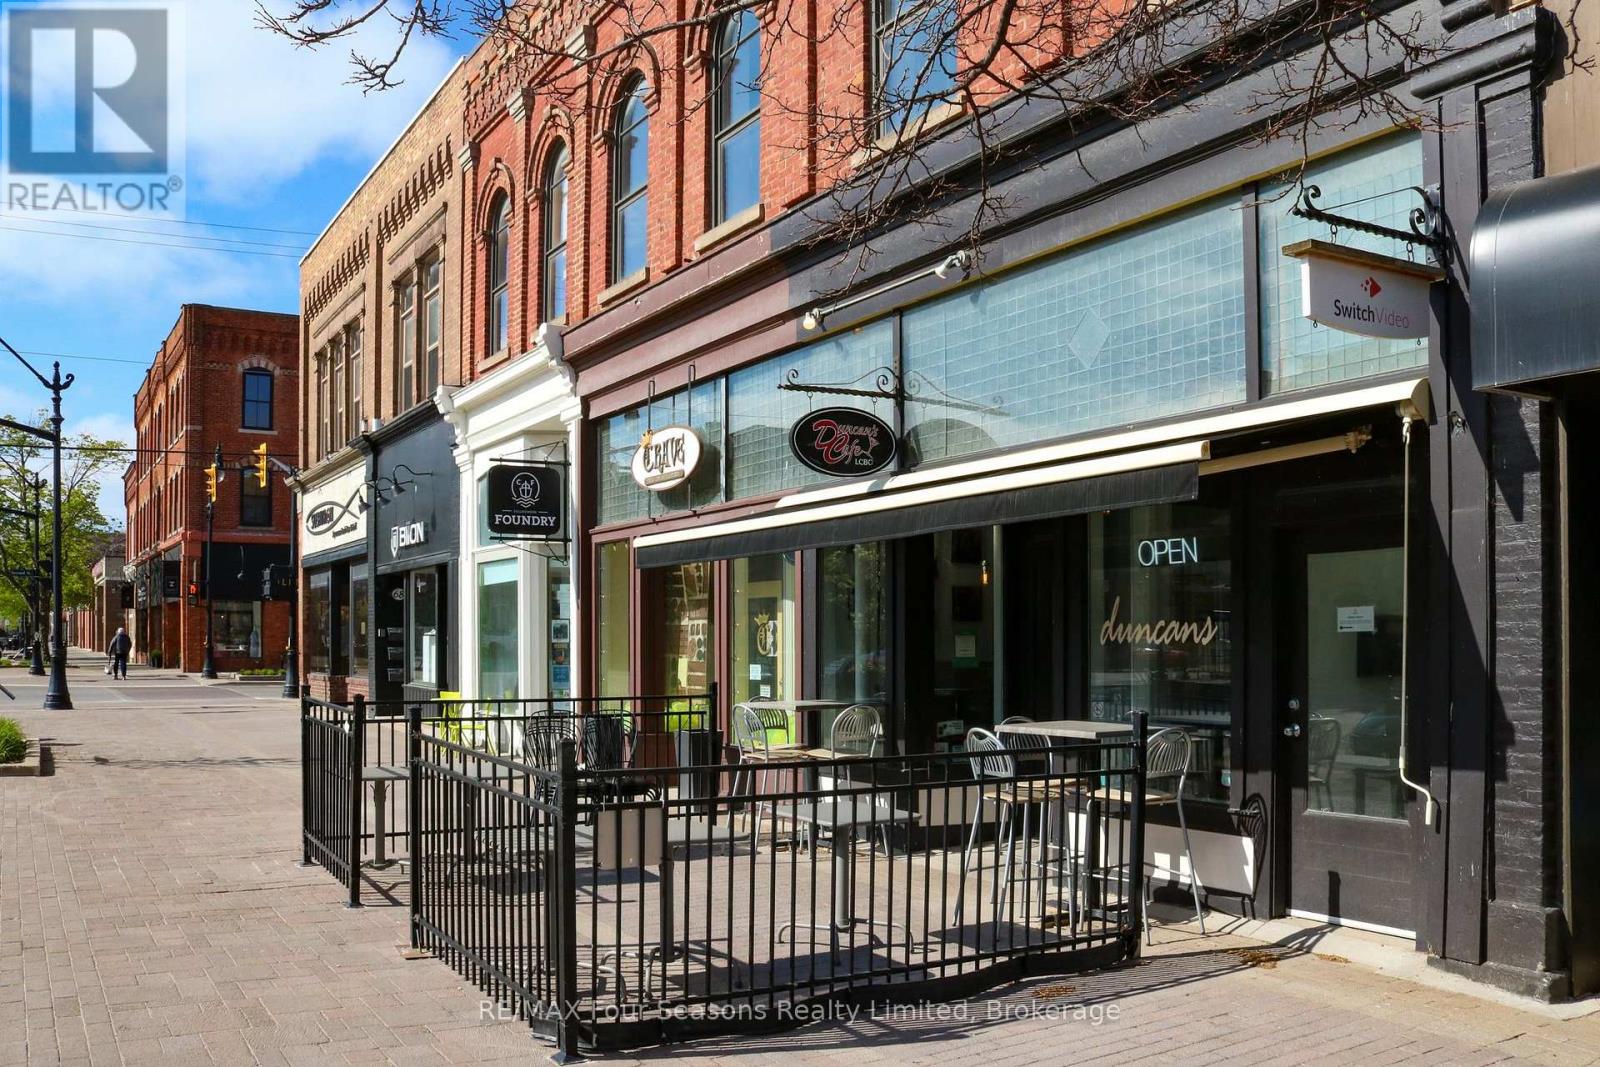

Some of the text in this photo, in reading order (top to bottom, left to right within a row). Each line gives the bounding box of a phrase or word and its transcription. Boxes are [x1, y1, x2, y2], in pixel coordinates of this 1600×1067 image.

[1334, 299, 1410, 329] SwitchVideo
[494, 514, 557, 527] FOUNDRY
[1137, 536, 1198, 566] OPEN
[1100, 595, 1219, 646] duncans
